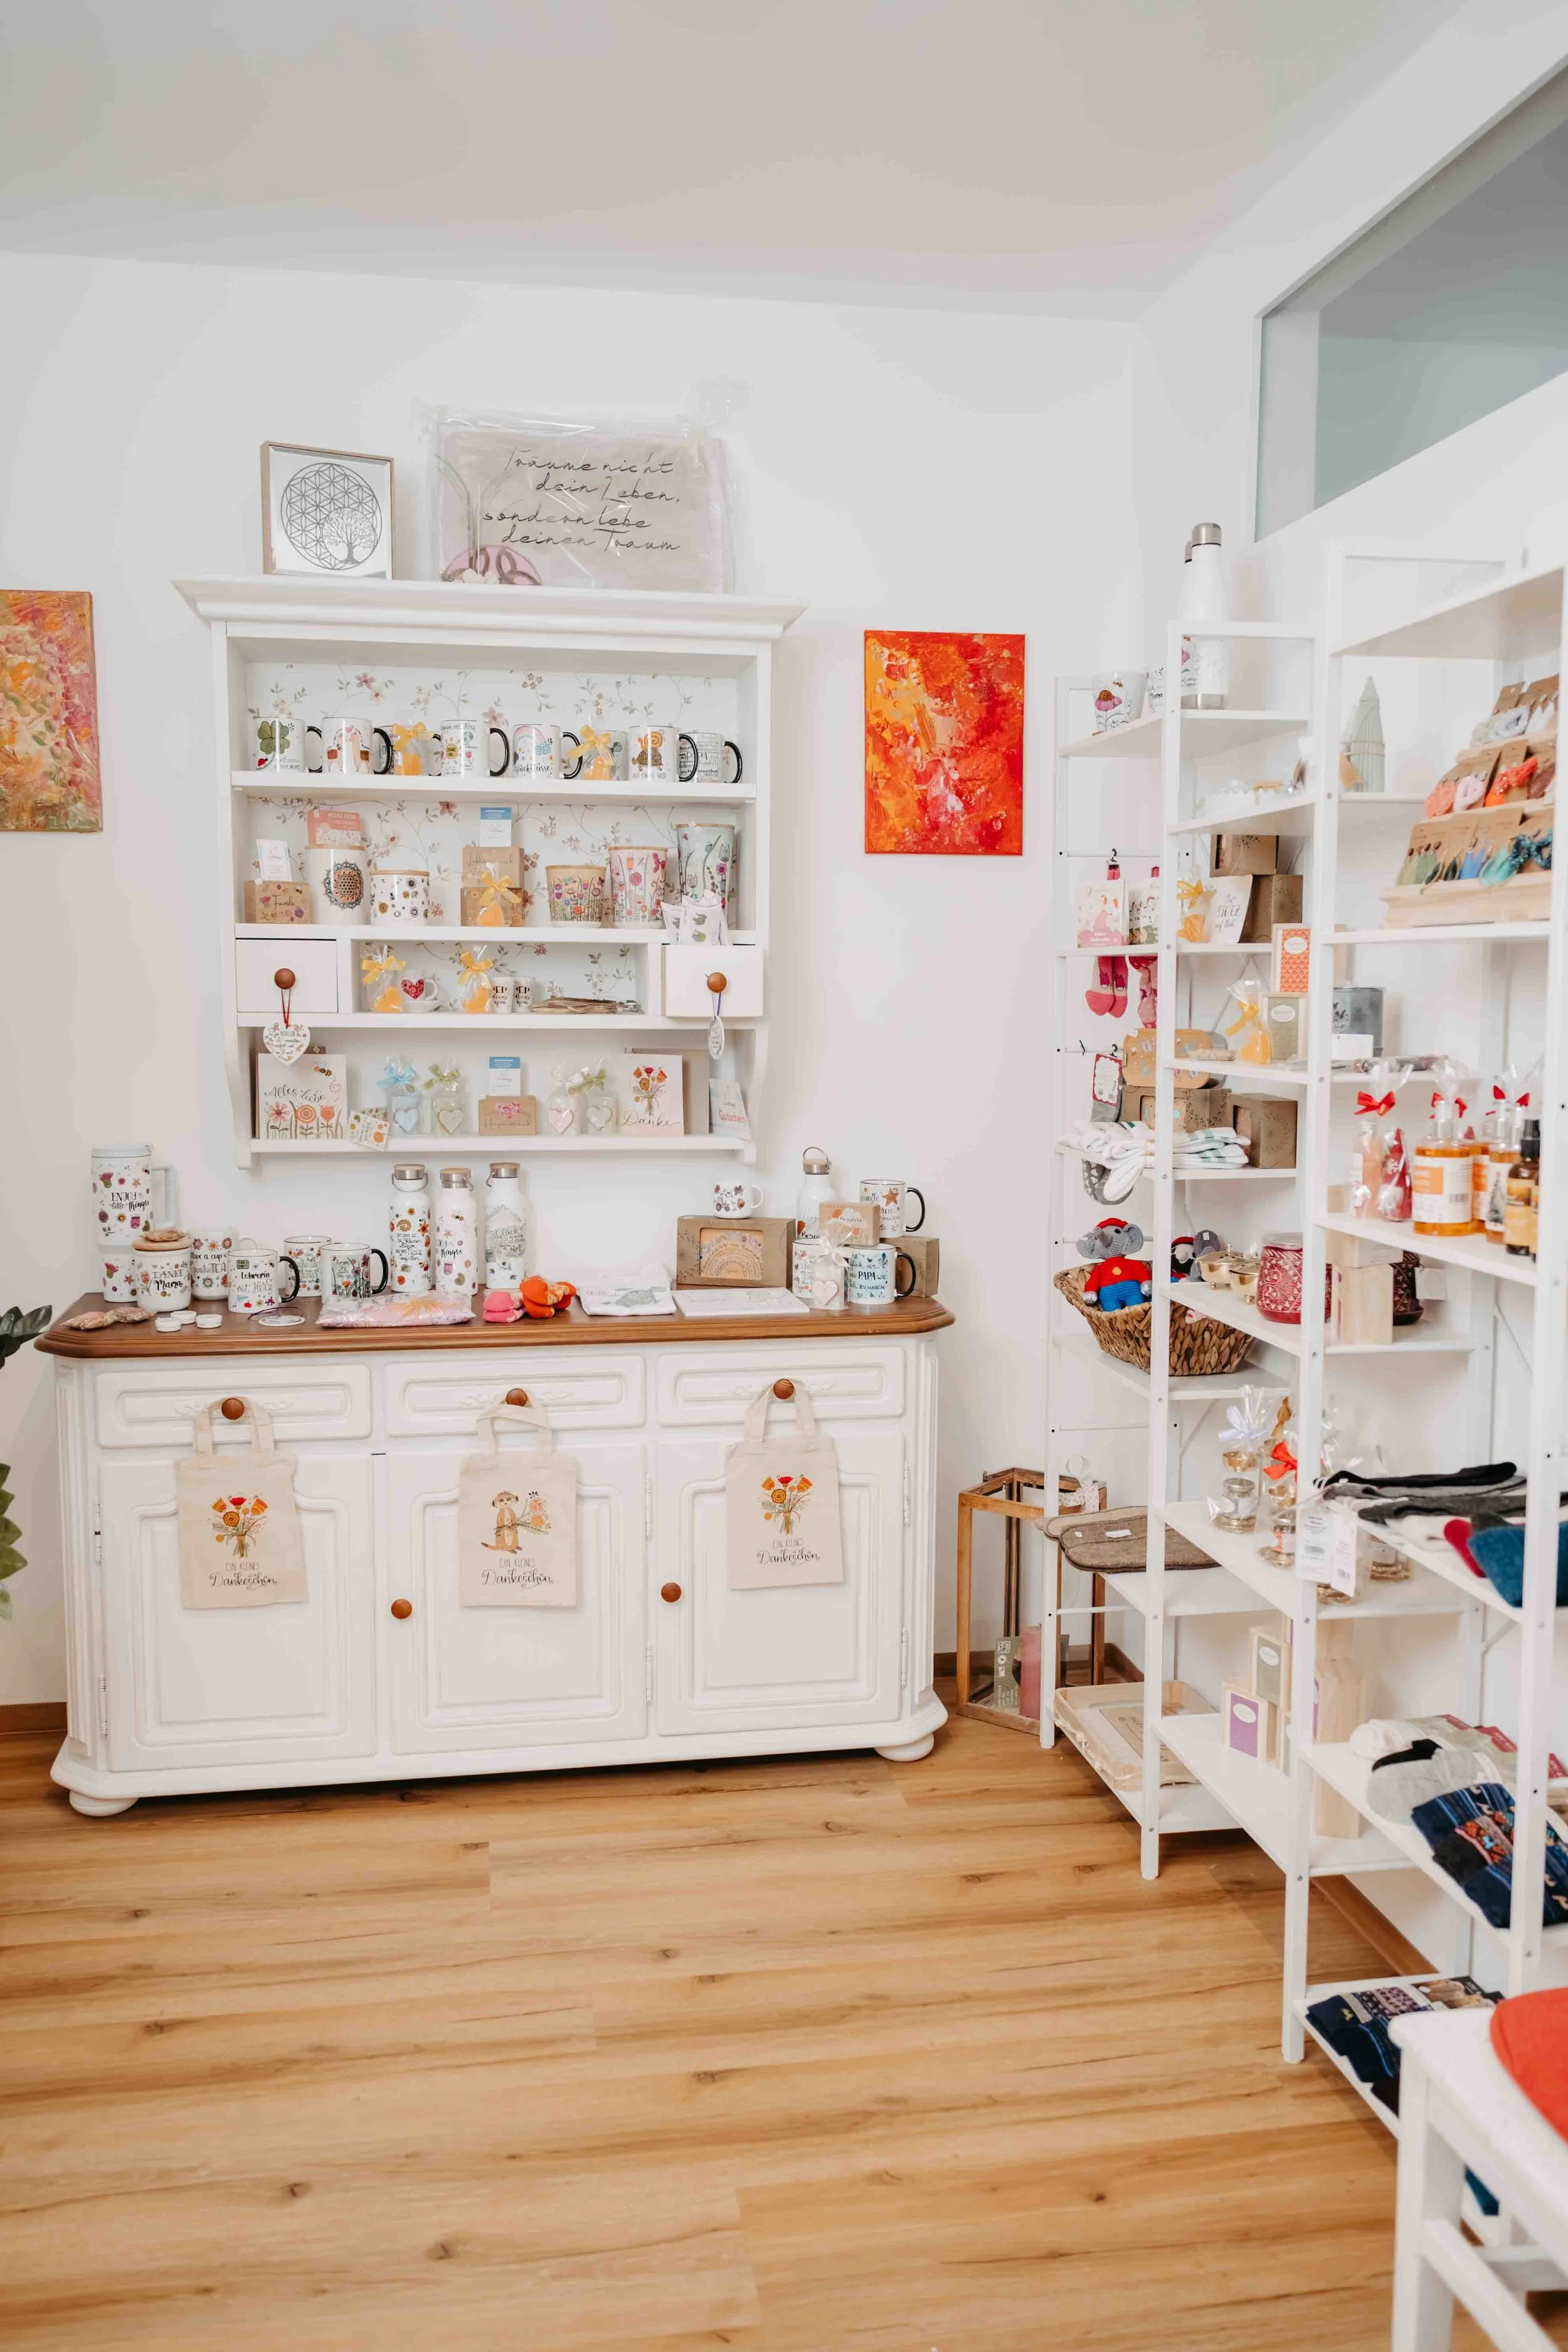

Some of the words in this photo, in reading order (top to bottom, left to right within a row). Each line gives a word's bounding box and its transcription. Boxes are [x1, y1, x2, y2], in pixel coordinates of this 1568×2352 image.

[504, 450, 598, 470] Träume
[603, 452, 673, 473] nicht
[536, 472, 598, 492] dein
[483, 503, 595, 526] sondern
[598, 506, 652, 527] lebe
[502, 524, 596, 544] deinen
[593, 527, 681, 552] Traum
[264, 1084, 297, 1098] Alles
[622, 1110, 680, 1128] Danke
[112, 1192, 136, 1201] ENJOY
[129, 1200, 147, 1212] things
[859, 1271, 876, 1280] PAPA
[499, 1558, 511, 1568] EIN
[514, 1558, 536, 1568] KLEINES
[756, 1547, 820, 1566] Dankeschön
[225, 1561, 237, 1572] EIN
[209, 1571, 278, 1591] Dankeschön
[481, 1568, 554, 1589] Dankeschön
